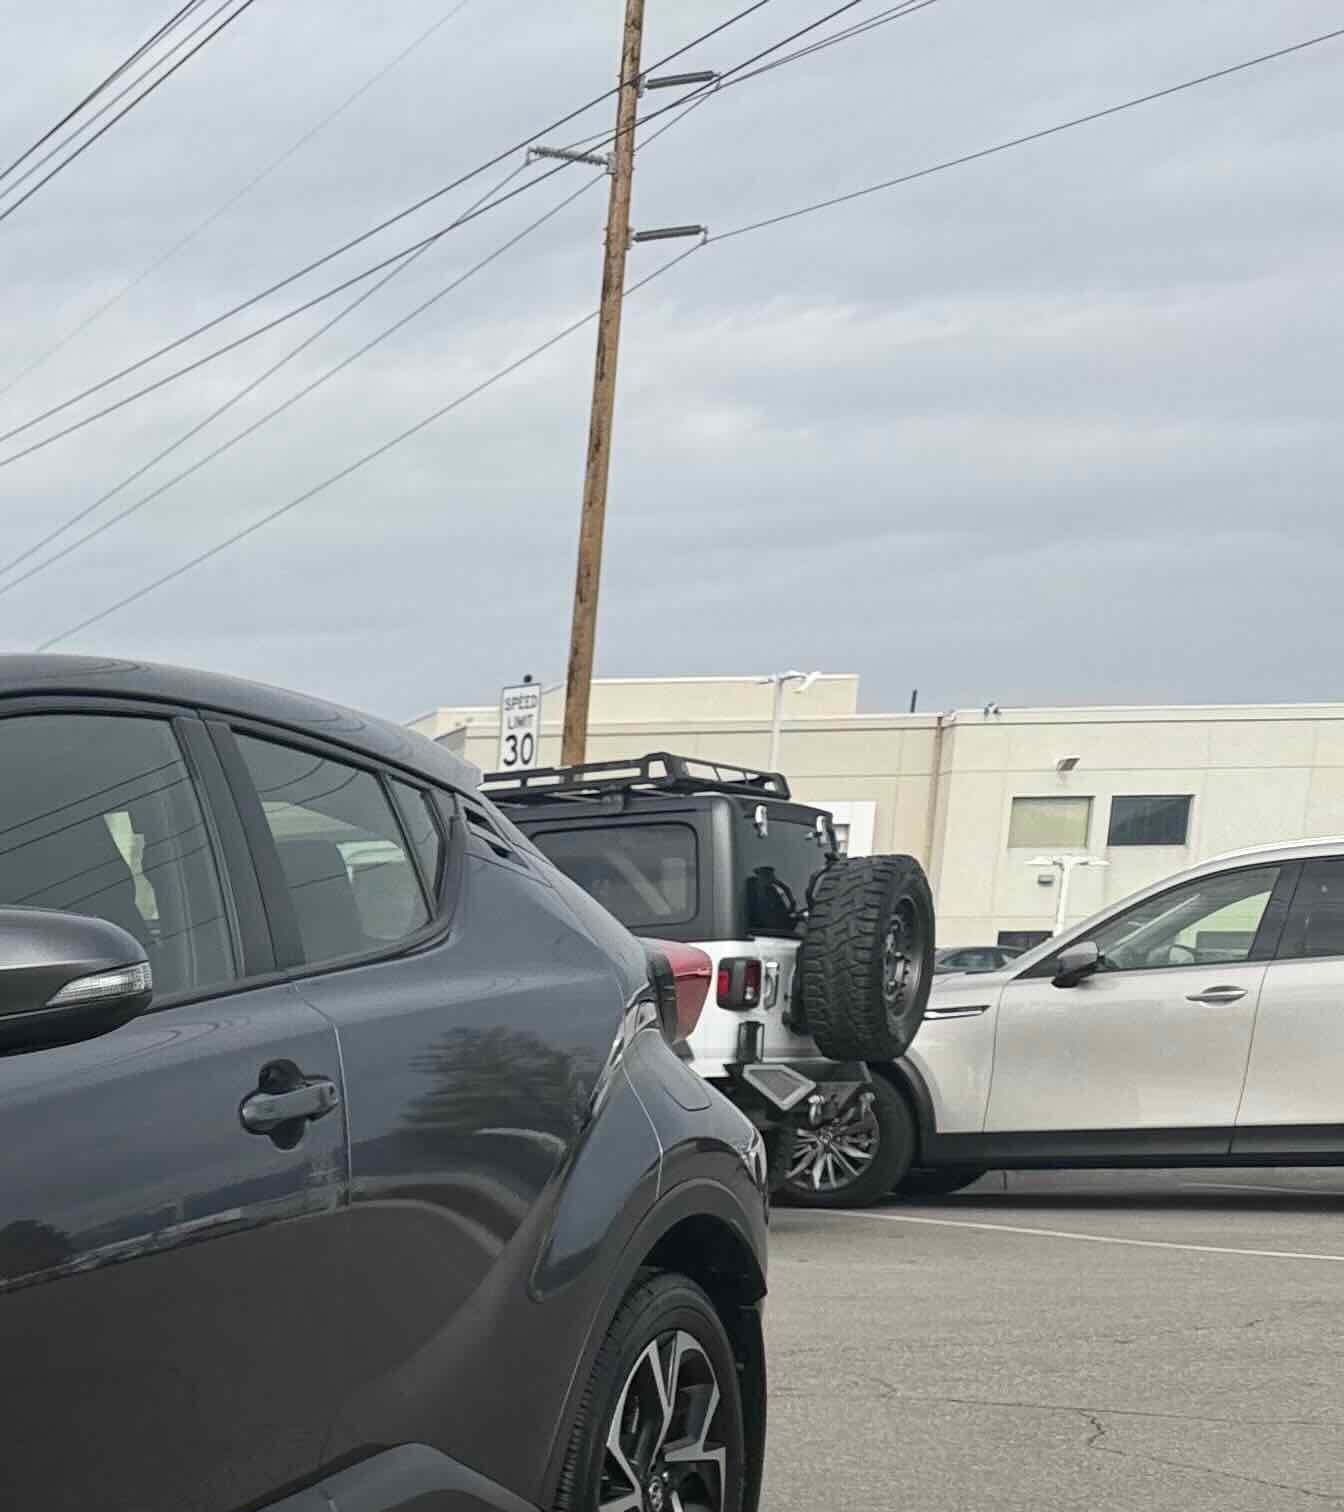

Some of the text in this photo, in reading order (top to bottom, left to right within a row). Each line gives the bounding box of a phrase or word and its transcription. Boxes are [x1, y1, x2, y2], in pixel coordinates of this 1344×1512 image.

[504, 694, 537, 711] SPEED
[507, 714, 534, 730] LIMIT
[503, 732, 534, 767] 30
